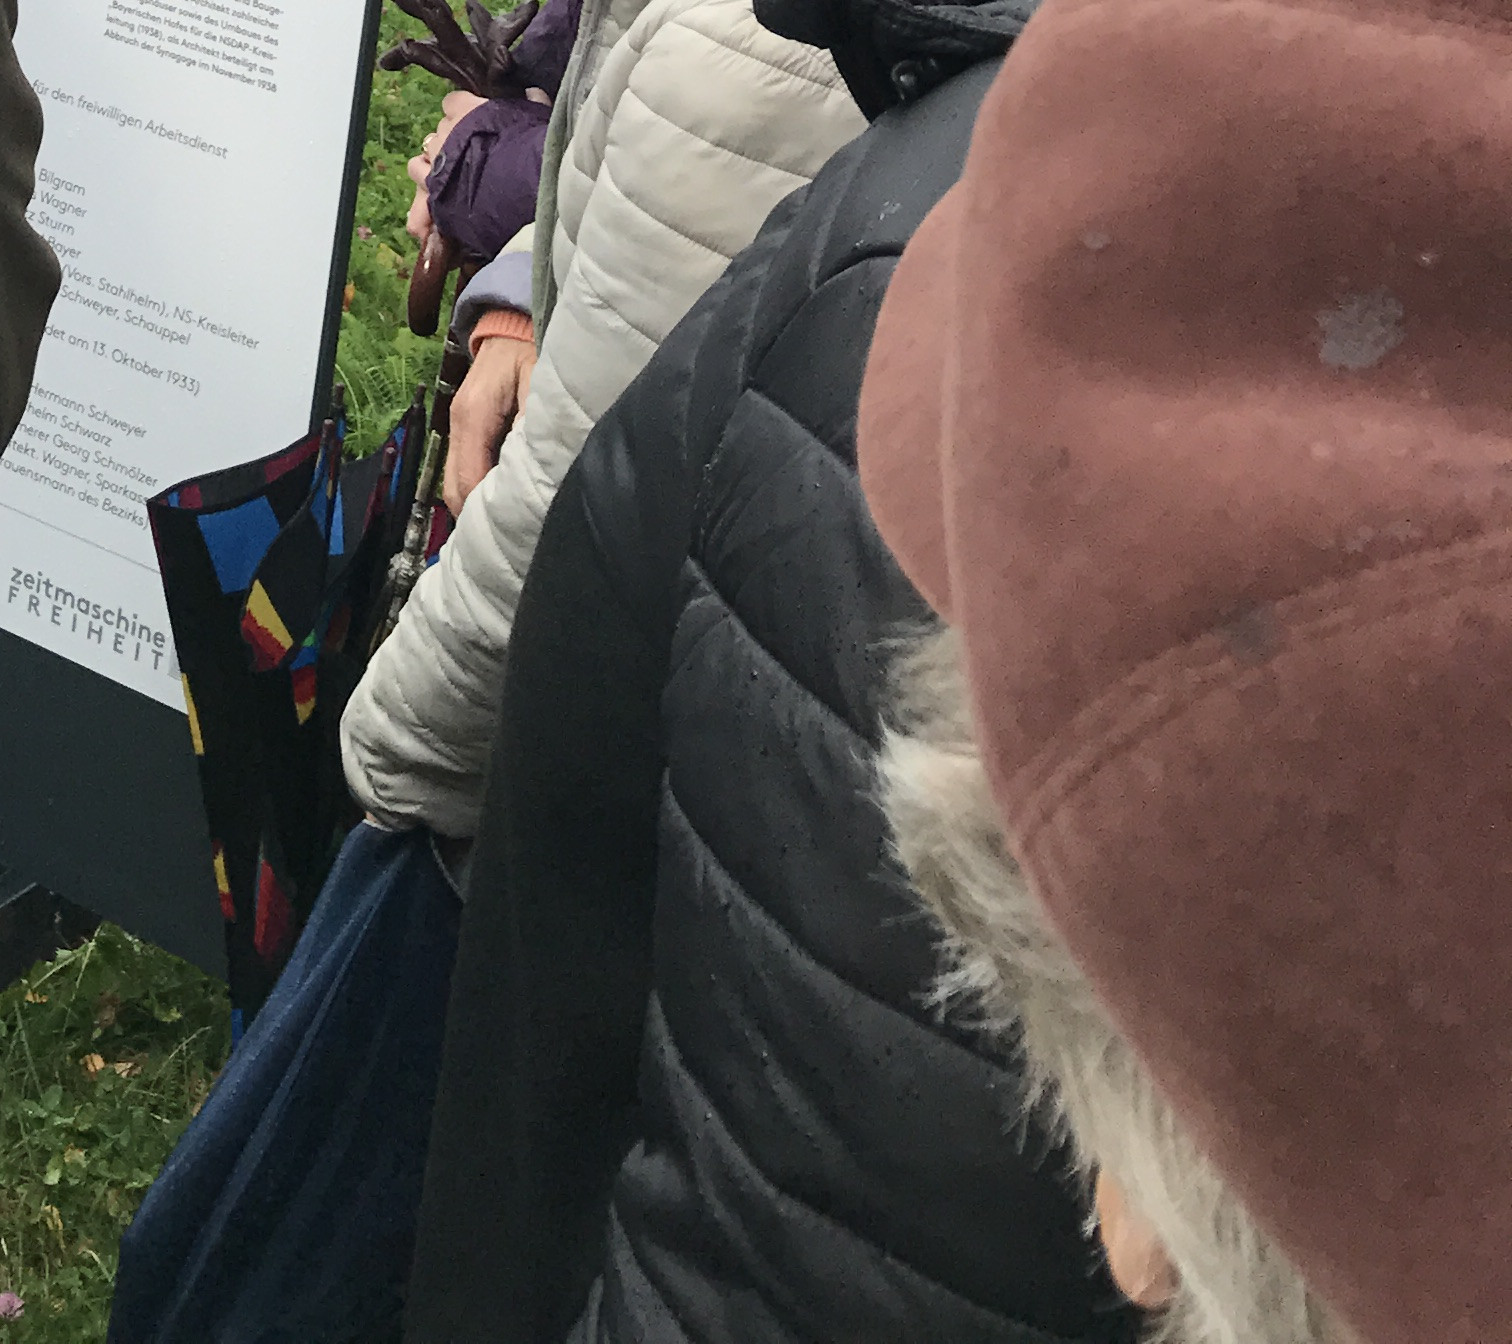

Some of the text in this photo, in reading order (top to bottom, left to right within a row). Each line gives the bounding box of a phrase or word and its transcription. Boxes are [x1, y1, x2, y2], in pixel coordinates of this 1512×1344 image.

[24, 400, 58, 425] helm
[0, 457, 76, 497] rauensmann
[6, 584, 164, 670] FREIHEIT
[9, 565, 168, 649] zeitmaschine
